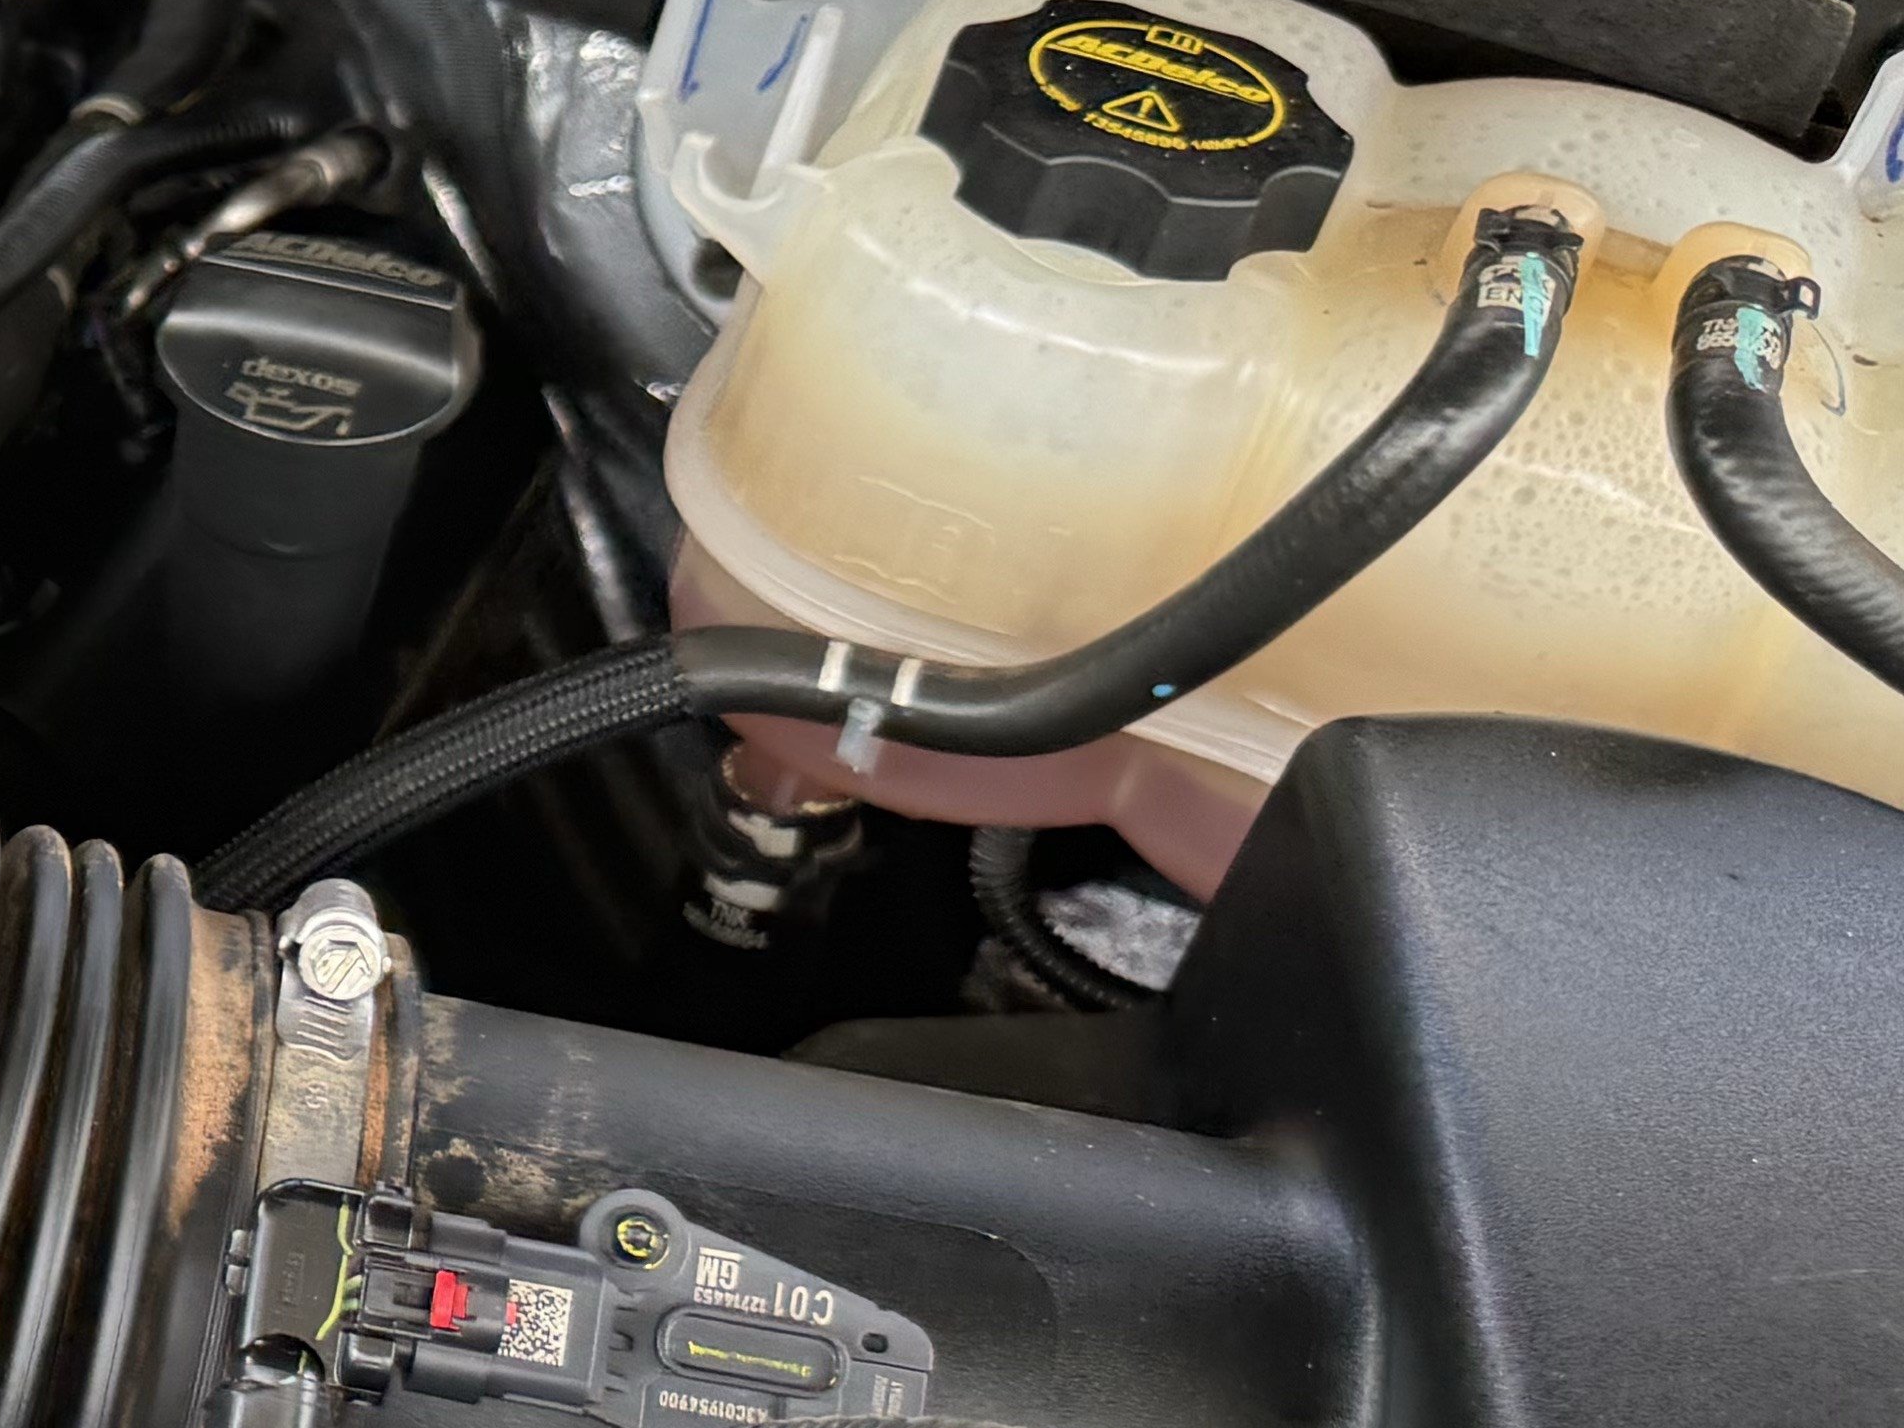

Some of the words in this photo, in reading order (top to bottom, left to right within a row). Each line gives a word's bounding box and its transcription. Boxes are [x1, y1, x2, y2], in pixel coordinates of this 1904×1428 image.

[1054, 34, 1271, 103] ACDelco
[241, 355, 363, 397] dexos
[695, 1254, 739, 1291] GM
[772, 1281, 834, 1326] C01
